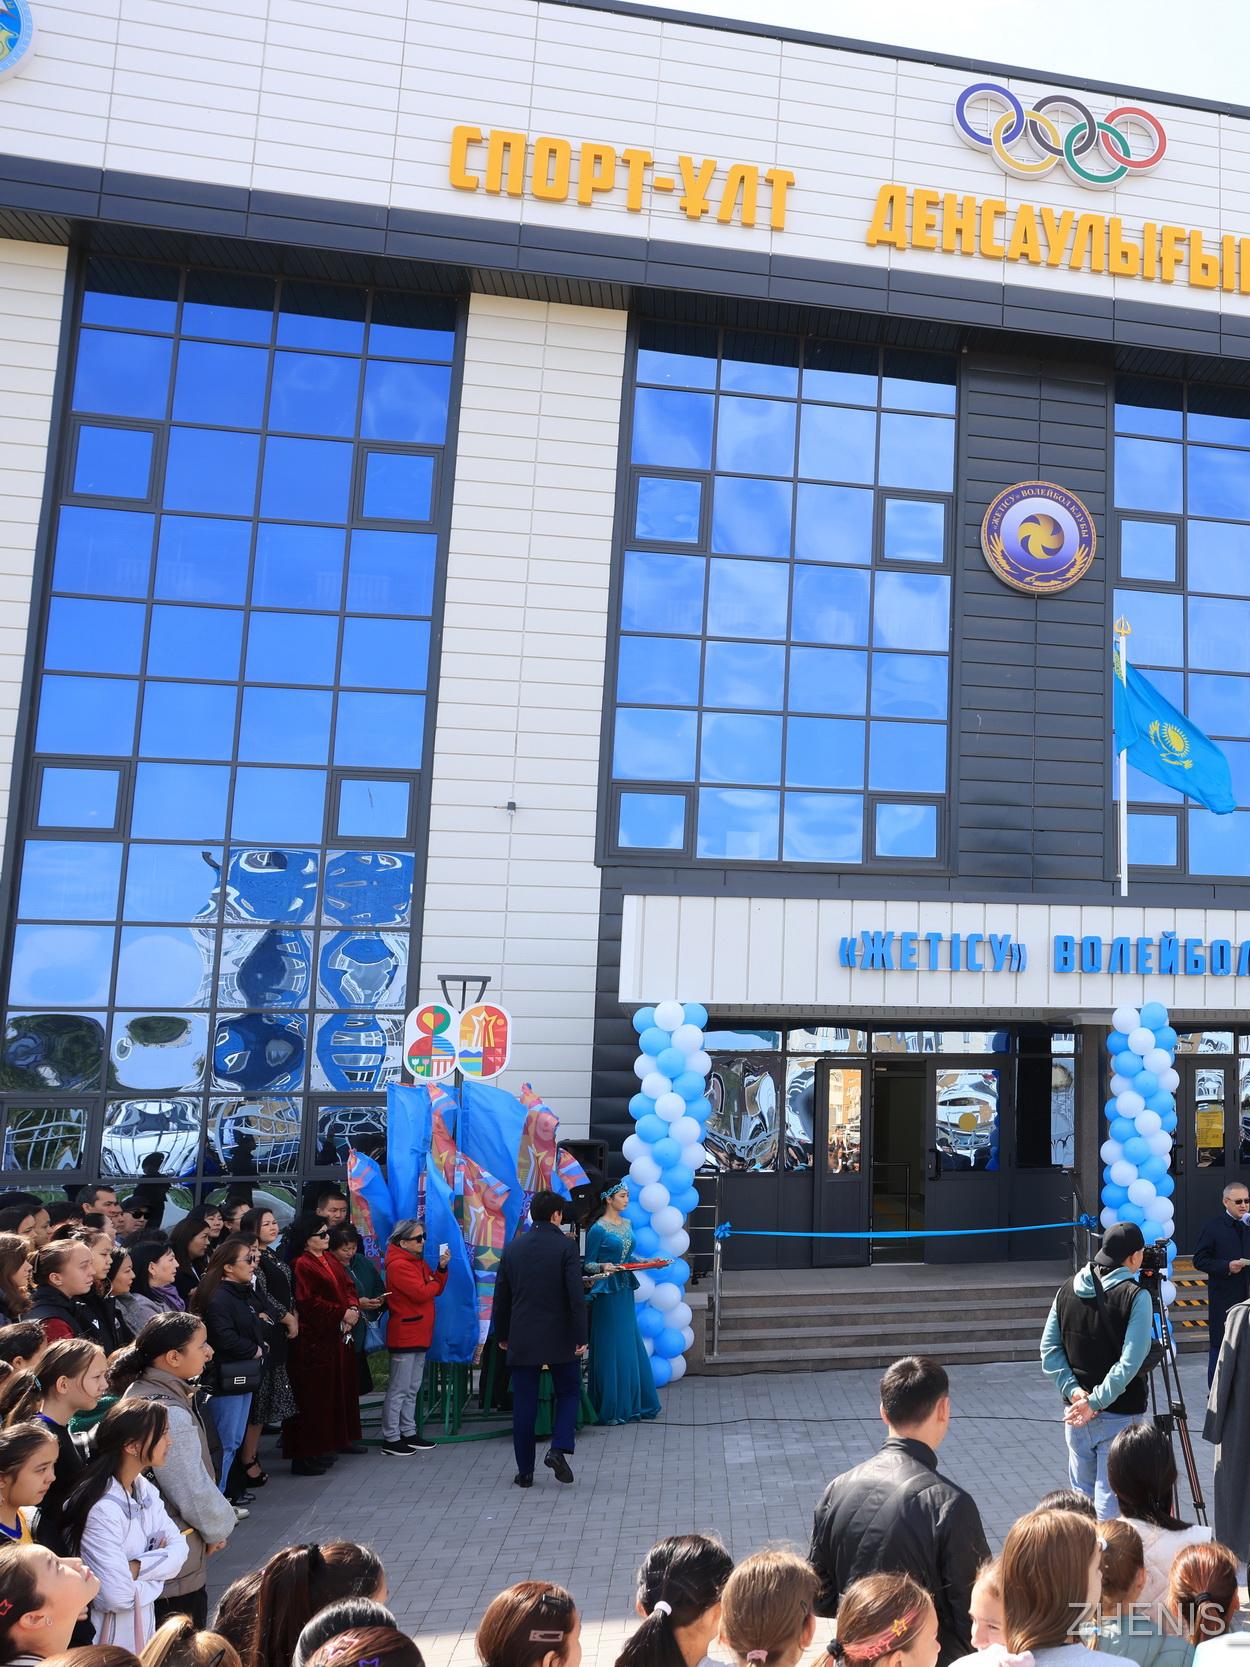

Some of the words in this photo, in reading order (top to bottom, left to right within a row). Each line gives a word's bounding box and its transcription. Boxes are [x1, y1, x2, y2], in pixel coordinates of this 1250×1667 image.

[449, 125, 796, 231] СПОРТ-ҰЛТ
[1020, 488, 1071, 507] ВОЛЕЙБОЛ
[1069, 505, 1089, 538] КЛУБЫ
[839, 931, 1028, 973] «ЖЕТІСУ»
